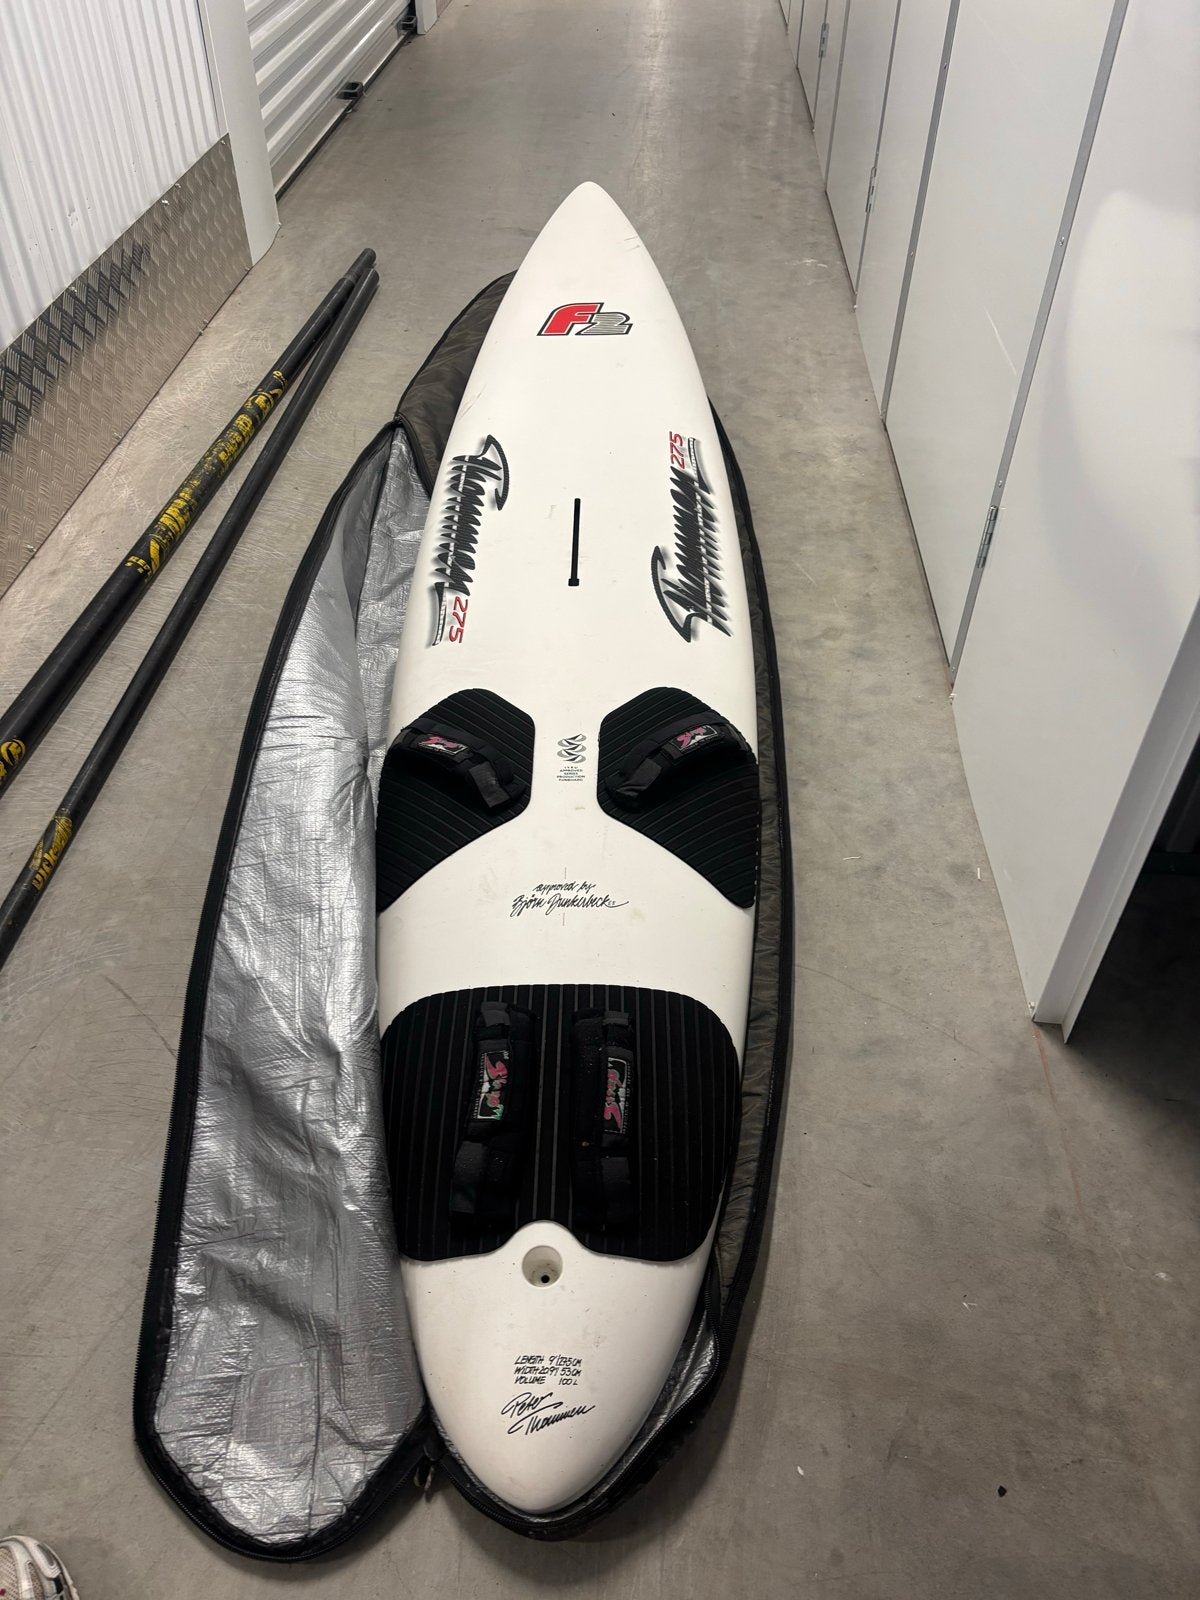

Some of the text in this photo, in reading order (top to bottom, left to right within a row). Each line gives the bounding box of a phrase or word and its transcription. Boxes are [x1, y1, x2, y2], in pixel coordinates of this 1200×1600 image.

[536, 302, 633, 336] F2
[669, 431, 686, 469] 275
[448, 596, 469, 643] 275
[577, 880, 597, 894] by
[514, 1354, 545, 1365] LENGTH
[514, 1366, 539, 1375] WIDTH
[514, 1375, 546, 1385] VOLUME
[501, 1392, 554, 1419] Peter
